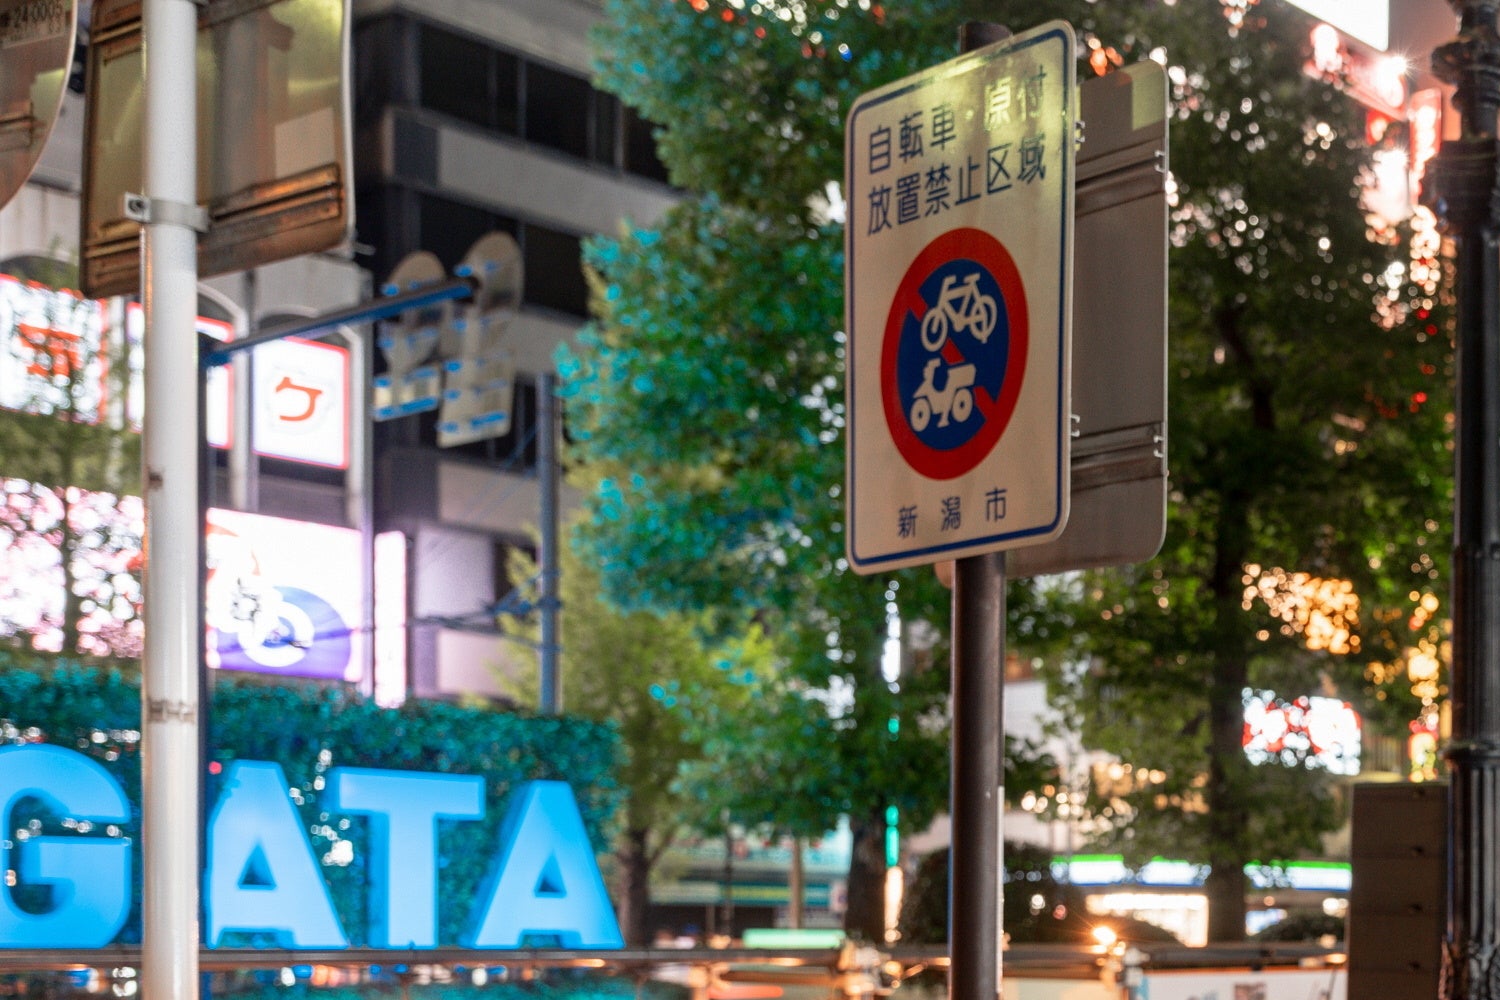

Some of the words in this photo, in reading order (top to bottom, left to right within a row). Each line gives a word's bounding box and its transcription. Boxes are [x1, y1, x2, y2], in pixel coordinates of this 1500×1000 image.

[867, 133, 1046, 236] 放置禁止区域
[897, 487, 1008, 538] 新潟市
